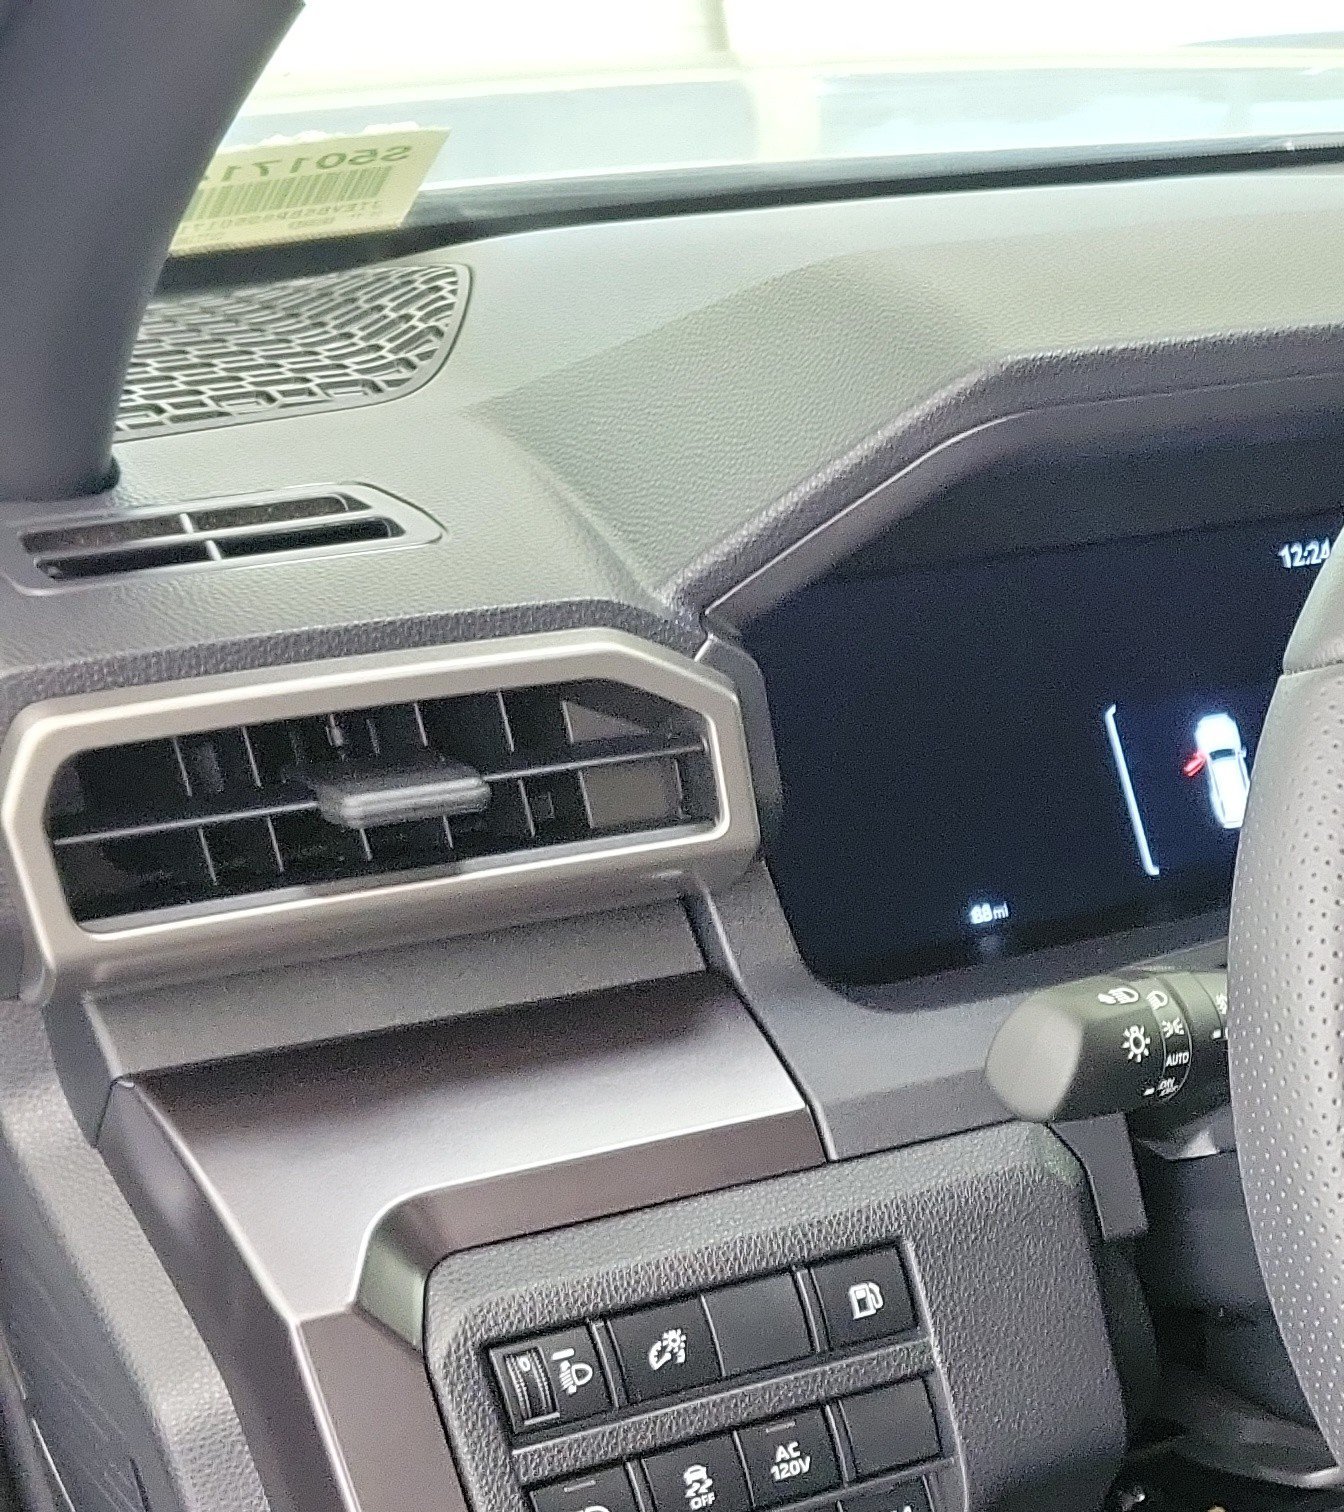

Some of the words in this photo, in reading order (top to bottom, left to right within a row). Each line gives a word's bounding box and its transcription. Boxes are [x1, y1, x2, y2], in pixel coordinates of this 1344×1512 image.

[1278, 537, 1330, 568] 12:24
[1166, 1051, 1189, 1067] AUTO
[775, 1441, 801, 1463] AC
[770, 1456, 811, 1481] 120V
[690, 1492, 715, 1510] OFF
